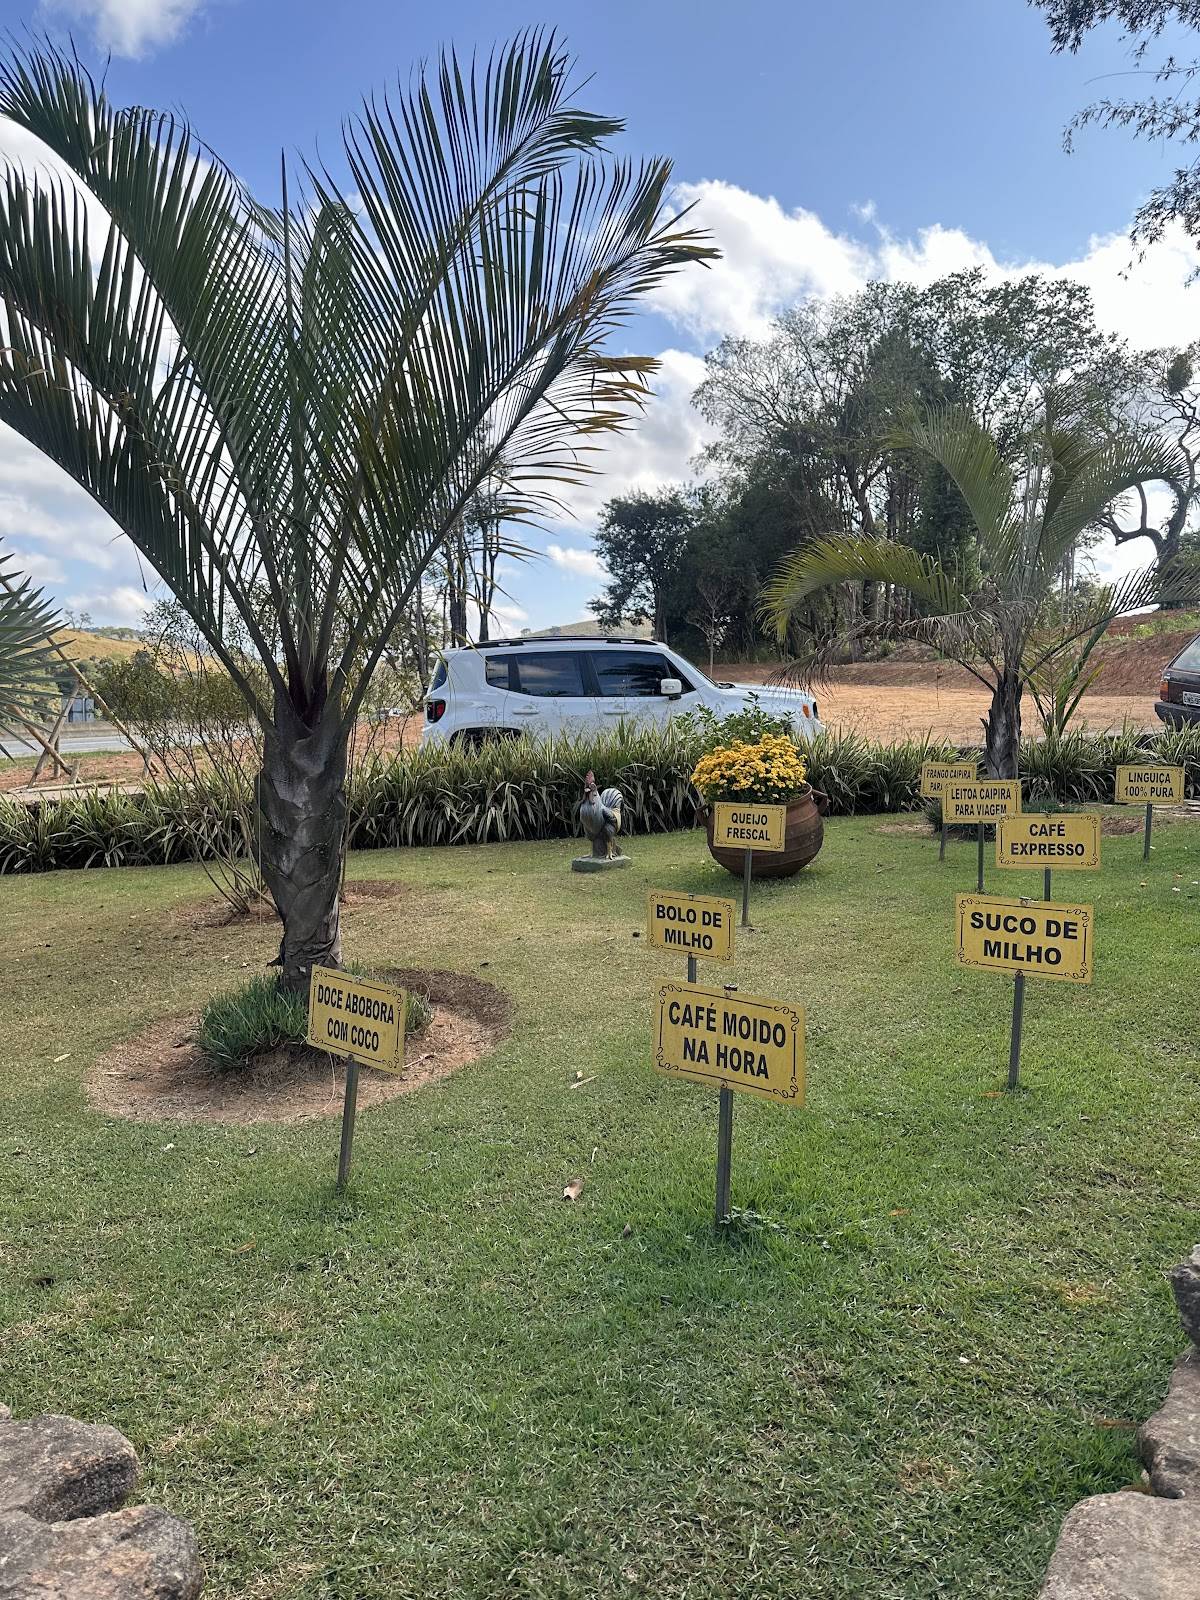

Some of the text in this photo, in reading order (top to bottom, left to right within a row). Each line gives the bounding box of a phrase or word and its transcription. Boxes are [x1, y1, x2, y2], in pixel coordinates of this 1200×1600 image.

[950, 770, 971, 779] CAIPIRA
[1128, 772, 1171, 786] LINGUIÇA
[952, 788, 1011, 800] LEITOA CAIPIRA
[1124, 786, 1174, 798] 100% PURA
[956, 804, 1006, 816] PARA VIAGEM
[732, 812, 768, 825] QUEIJO
[727, 827, 770, 841] FRESCAL
[1029, 821, 1066, 837] CAFÉ
[1010, 842, 1085, 856] EXPRESSO
[656, 904, 722, 928] BOLO DE
[970, 912, 1078, 940] SUCO DE
[664, 928, 712, 950] MILHO
[984, 940, 1062, 965] MILHO
[318, 984, 394, 1024] DOCE ABOBORA
[668, 1001, 786, 1048] CAFÉ MOIDO
[327, 1018, 379, 1052] COM COCO
[683, 1037, 769, 1079] NA HORA
